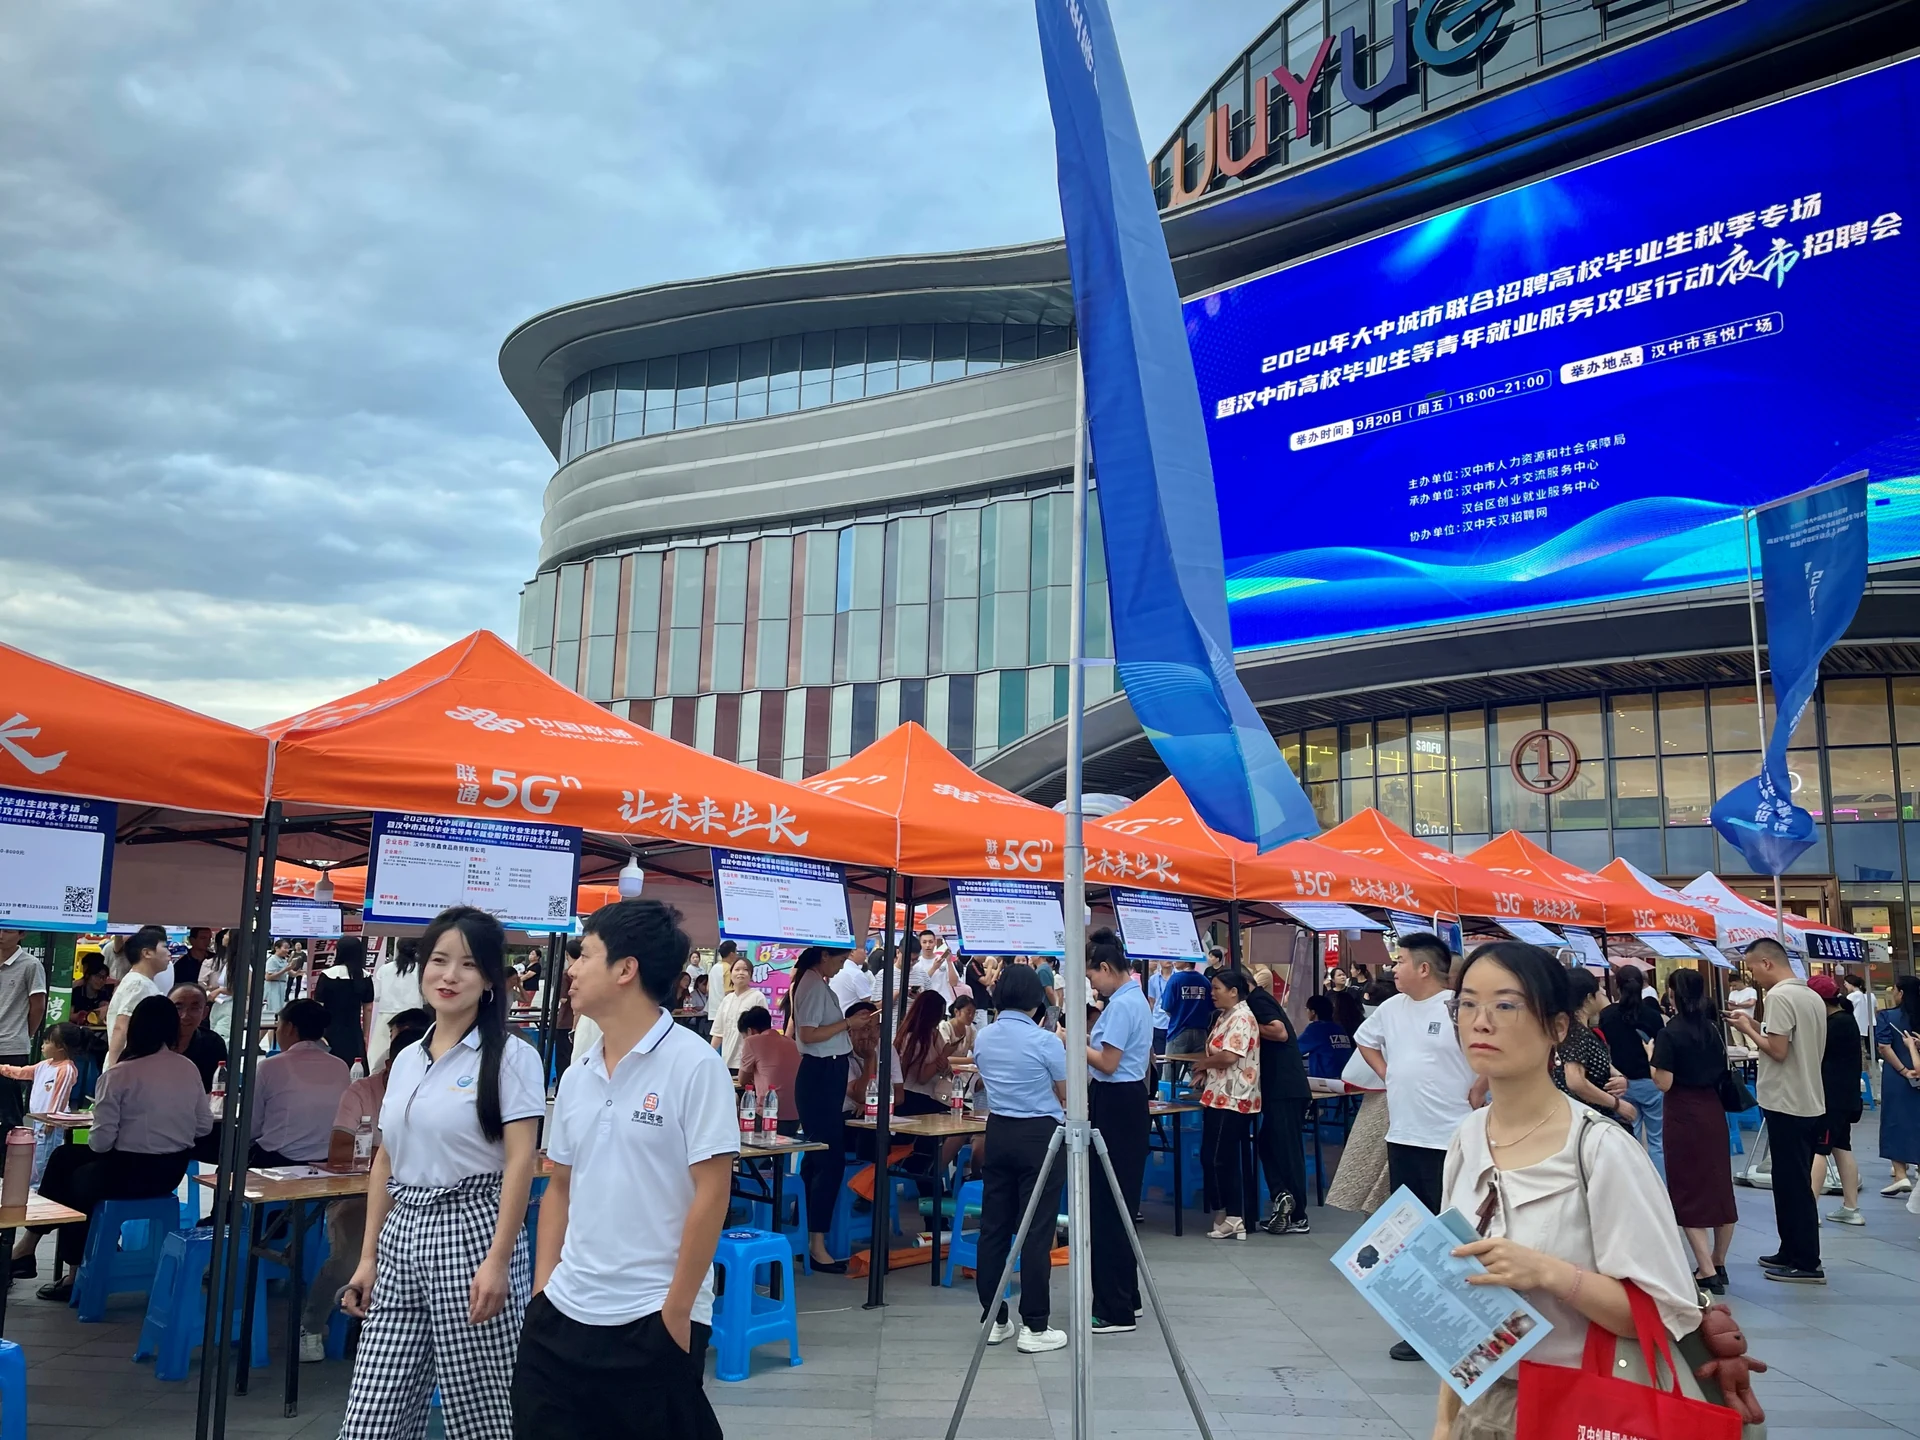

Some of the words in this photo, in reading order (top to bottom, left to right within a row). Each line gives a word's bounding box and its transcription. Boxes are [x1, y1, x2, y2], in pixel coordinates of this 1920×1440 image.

[1261, 192, 1822, 374] 2024年大中城市联合招聘高校毕业生秋季专场
[1216, 212, 1903, 419] 暨汉中市高校毕业生等青年就业服务攻坚行动夜市招聘会
[1650, 317, 1773, 360] 汉中市吾悦广场
[1461, 478, 1600, 515] 汉台区创业就业服务中心
[527, 716, 634, 740] 中国联通
[455, 763, 480, 806] 联通
[0, 806, 100, 825] 攻坚行动夜市招聘会
[617, 788, 809, 847] 让未来生长
[1350, 877, 1420, 908] 让未来生长
